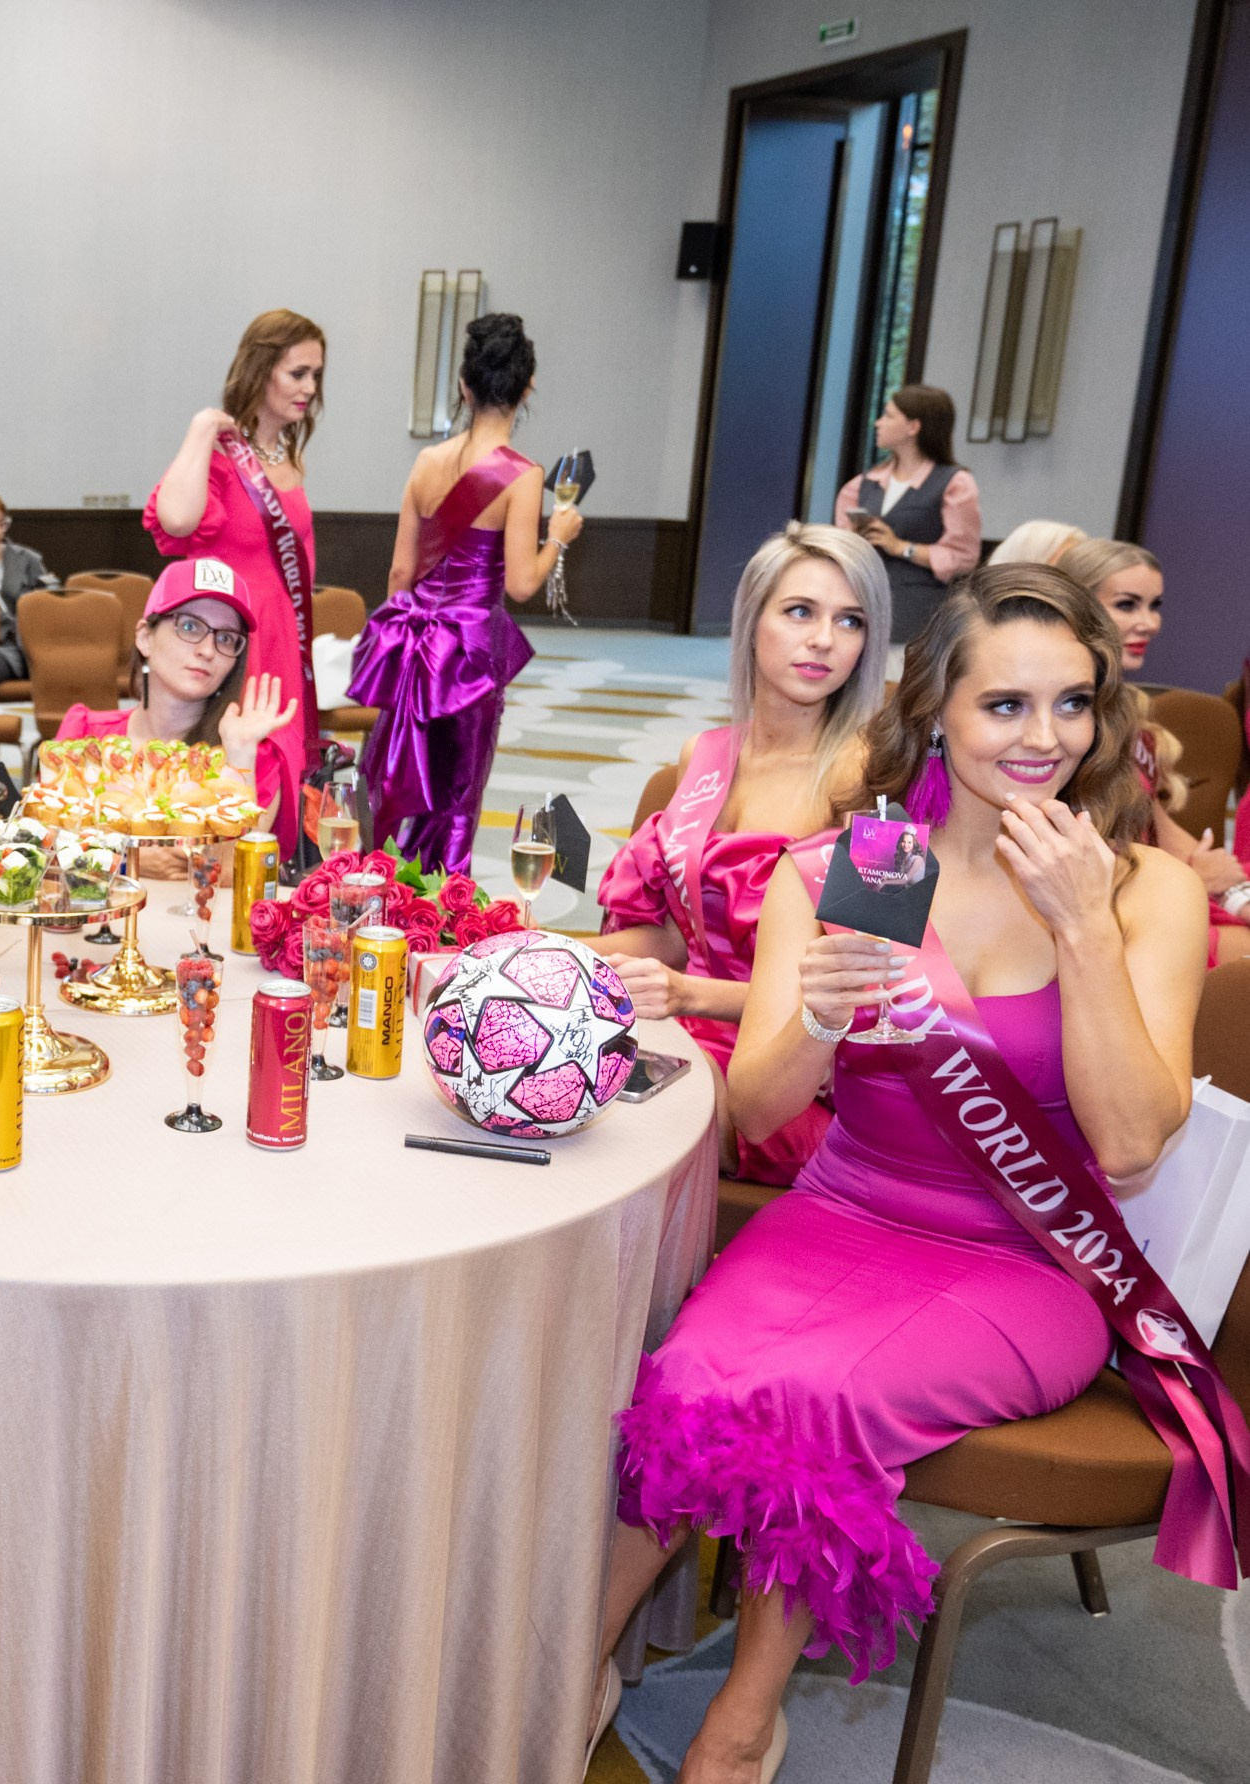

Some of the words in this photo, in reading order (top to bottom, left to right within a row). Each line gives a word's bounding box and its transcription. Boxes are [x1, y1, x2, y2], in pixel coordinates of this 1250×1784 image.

[253, 472, 291, 530] LADY
[858, 867, 908, 880] RTAMONOVA
[862, 875, 882, 884] YANA
[381, 975, 394, 1046] MANGO
[280, 1012, 307, 1132] MILANO
[931, 1048, 1069, 1213] WORLD
[1050, 1211, 1138, 1306] 2024
